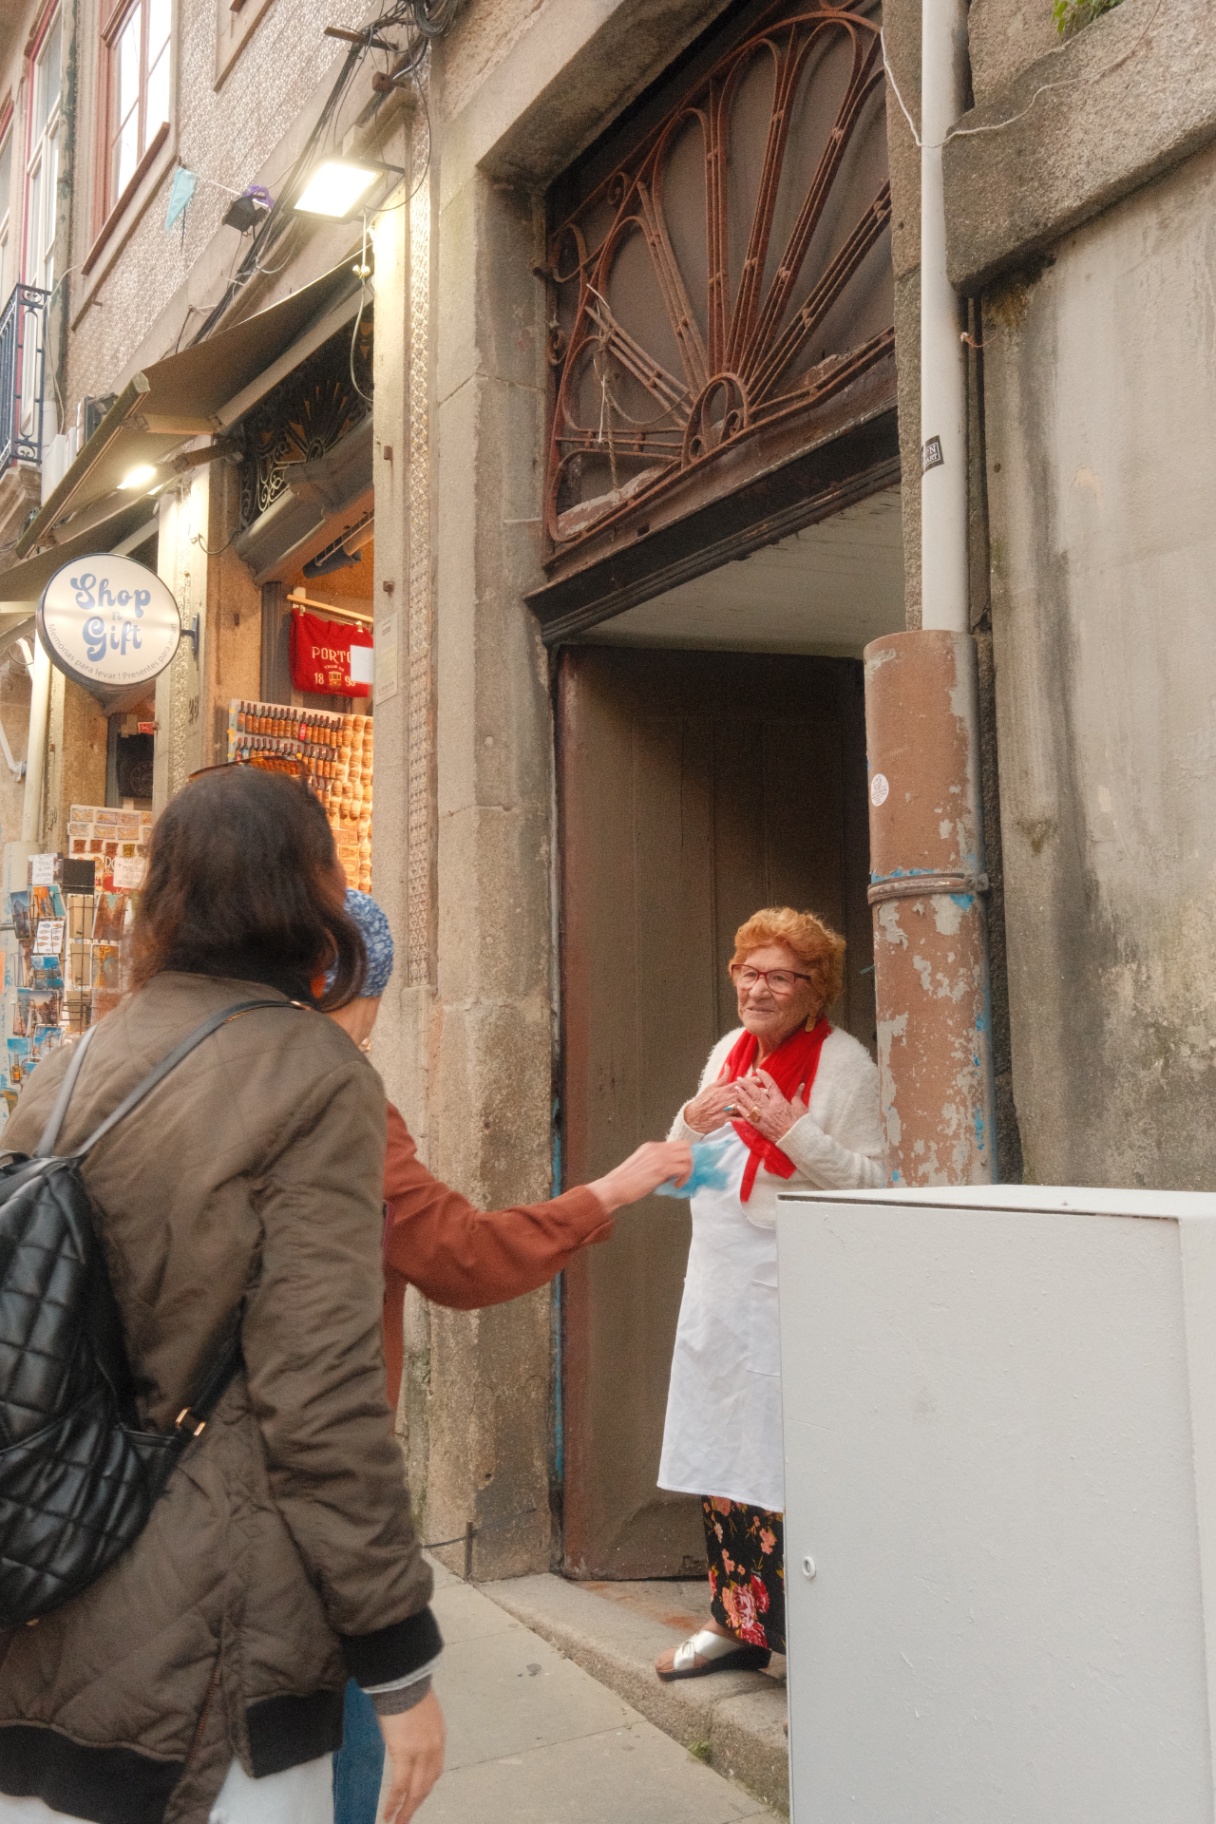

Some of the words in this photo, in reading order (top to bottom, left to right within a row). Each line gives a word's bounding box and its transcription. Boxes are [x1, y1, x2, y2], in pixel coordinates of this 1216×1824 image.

[70, 573, 151, 618] Shop
[48, 624, 75, 661] Memórias
[74, 659, 94, 674] para
[95, 668, 116, 679] levar
[122, 661, 160, 680] Presentes
[158, 646, 171, 663] para
[82, 616, 142, 662] Gift
[314, 672, 325, 685] 18
